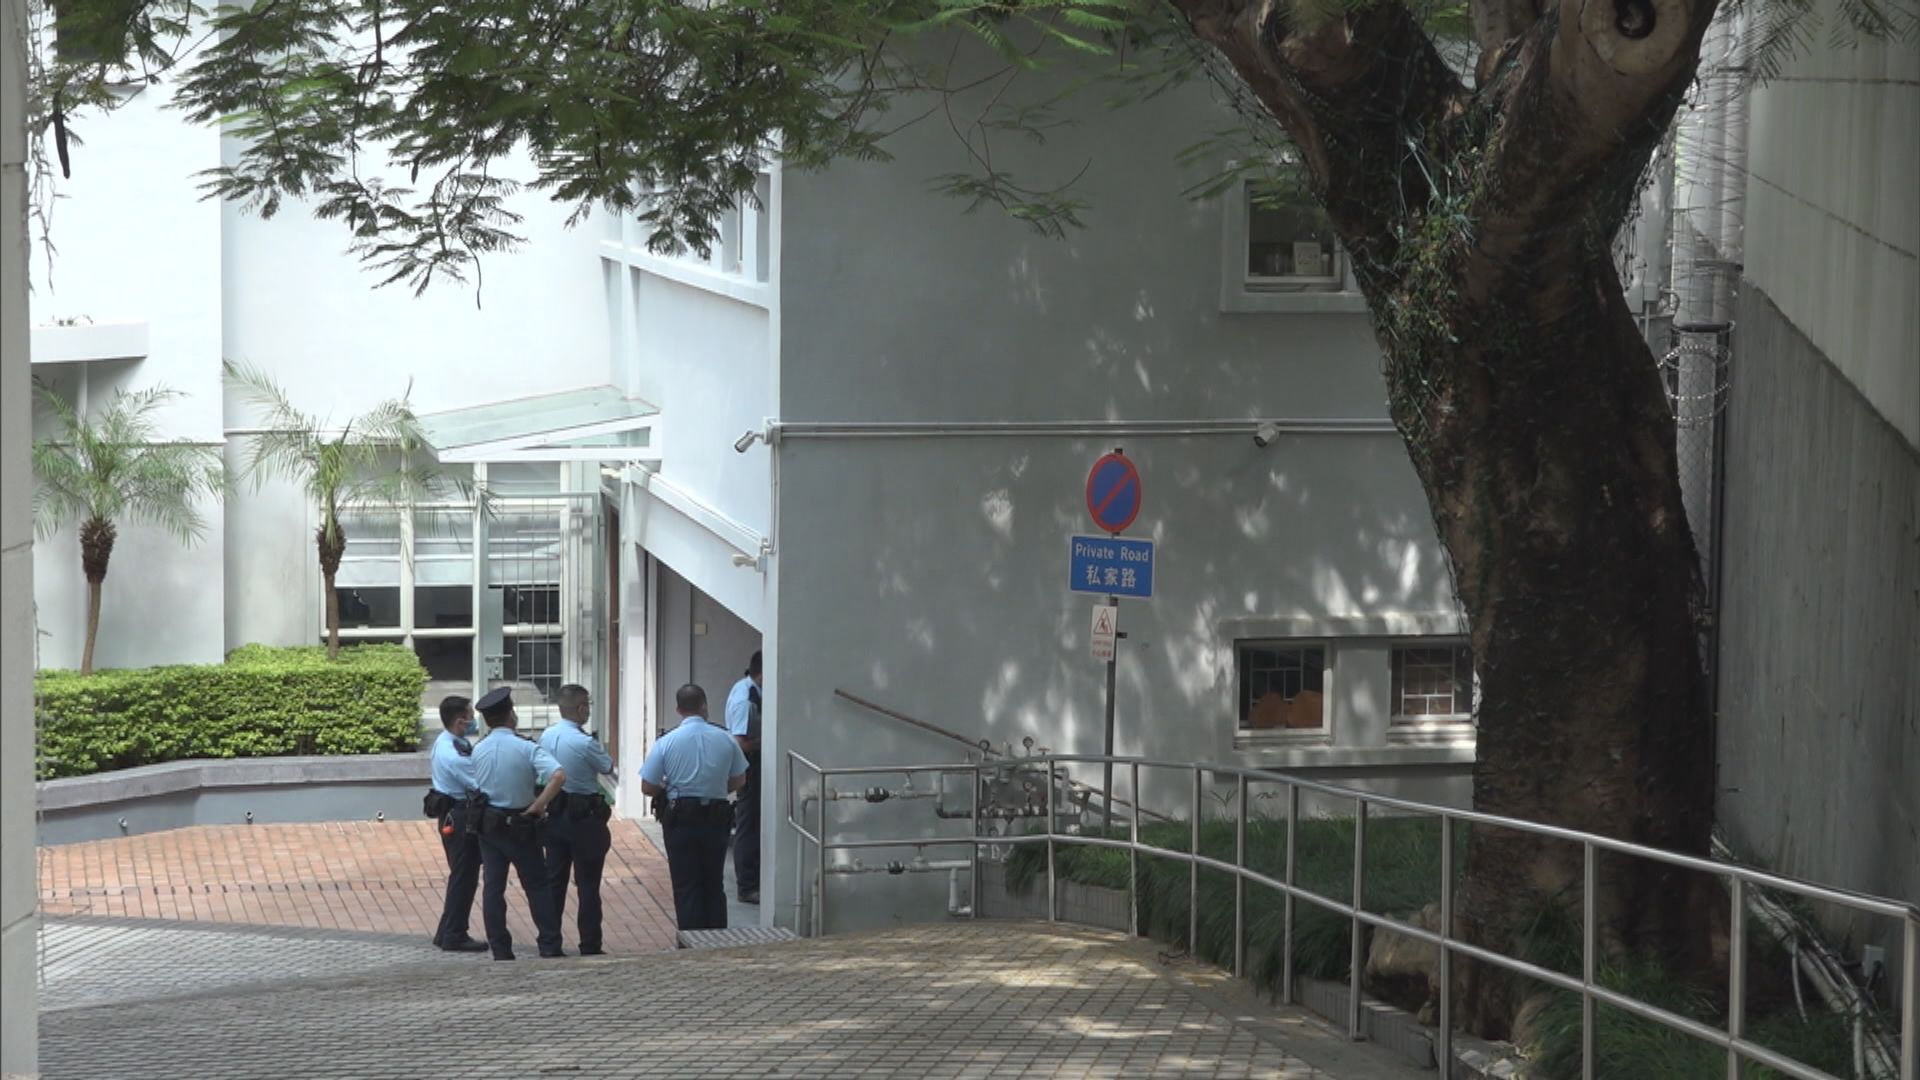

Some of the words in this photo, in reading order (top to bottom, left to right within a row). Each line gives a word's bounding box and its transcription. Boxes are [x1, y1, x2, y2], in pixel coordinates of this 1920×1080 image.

[1075, 543, 1115, 560] Private
[1120, 546, 1149, 562] Road
[1086, 564, 1136, 588] 私家路
